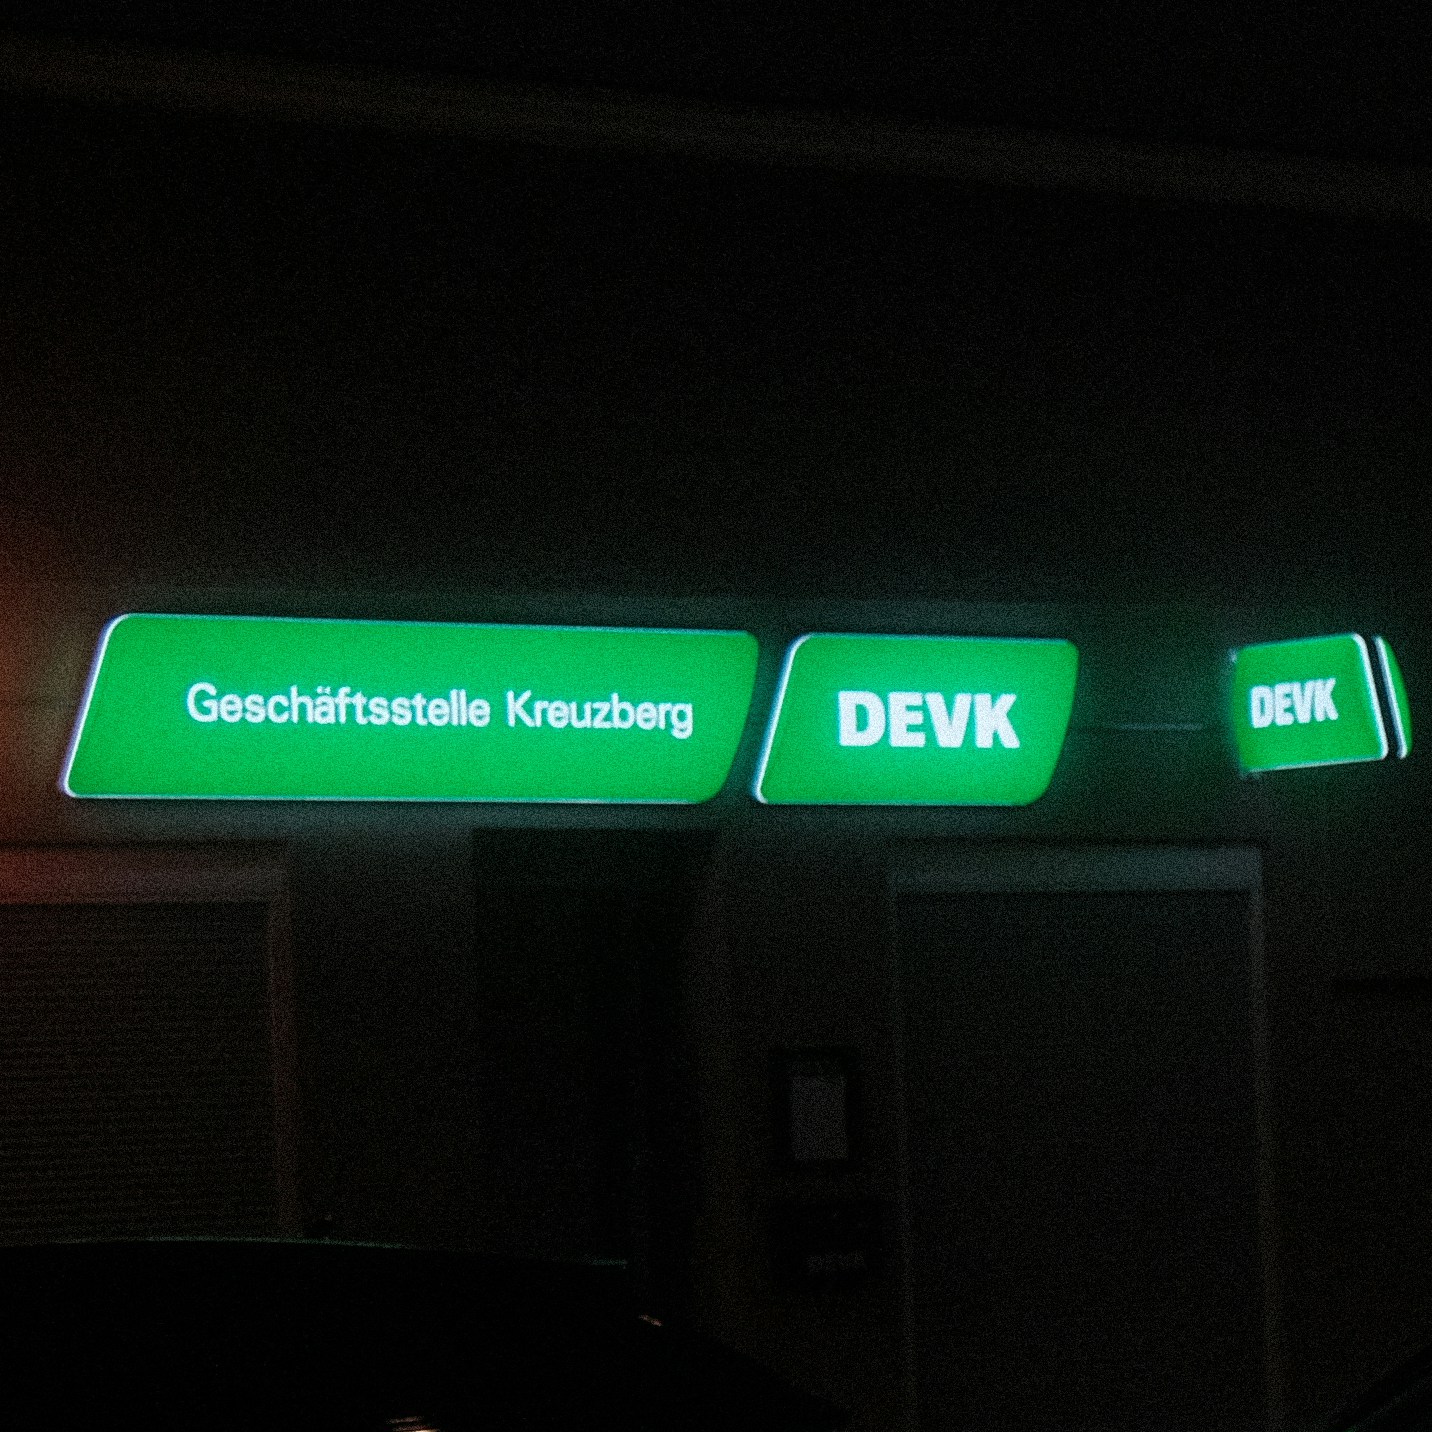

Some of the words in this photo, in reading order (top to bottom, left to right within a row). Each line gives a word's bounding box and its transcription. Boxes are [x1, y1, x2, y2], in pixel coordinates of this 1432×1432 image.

[185, 682, 490, 728] Geschäftsstelle
[506, 688, 693, 740] Kreuzberg
[837, 690, 1020, 749] DEVK
[1250, 677, 1339, 729] DEVK
